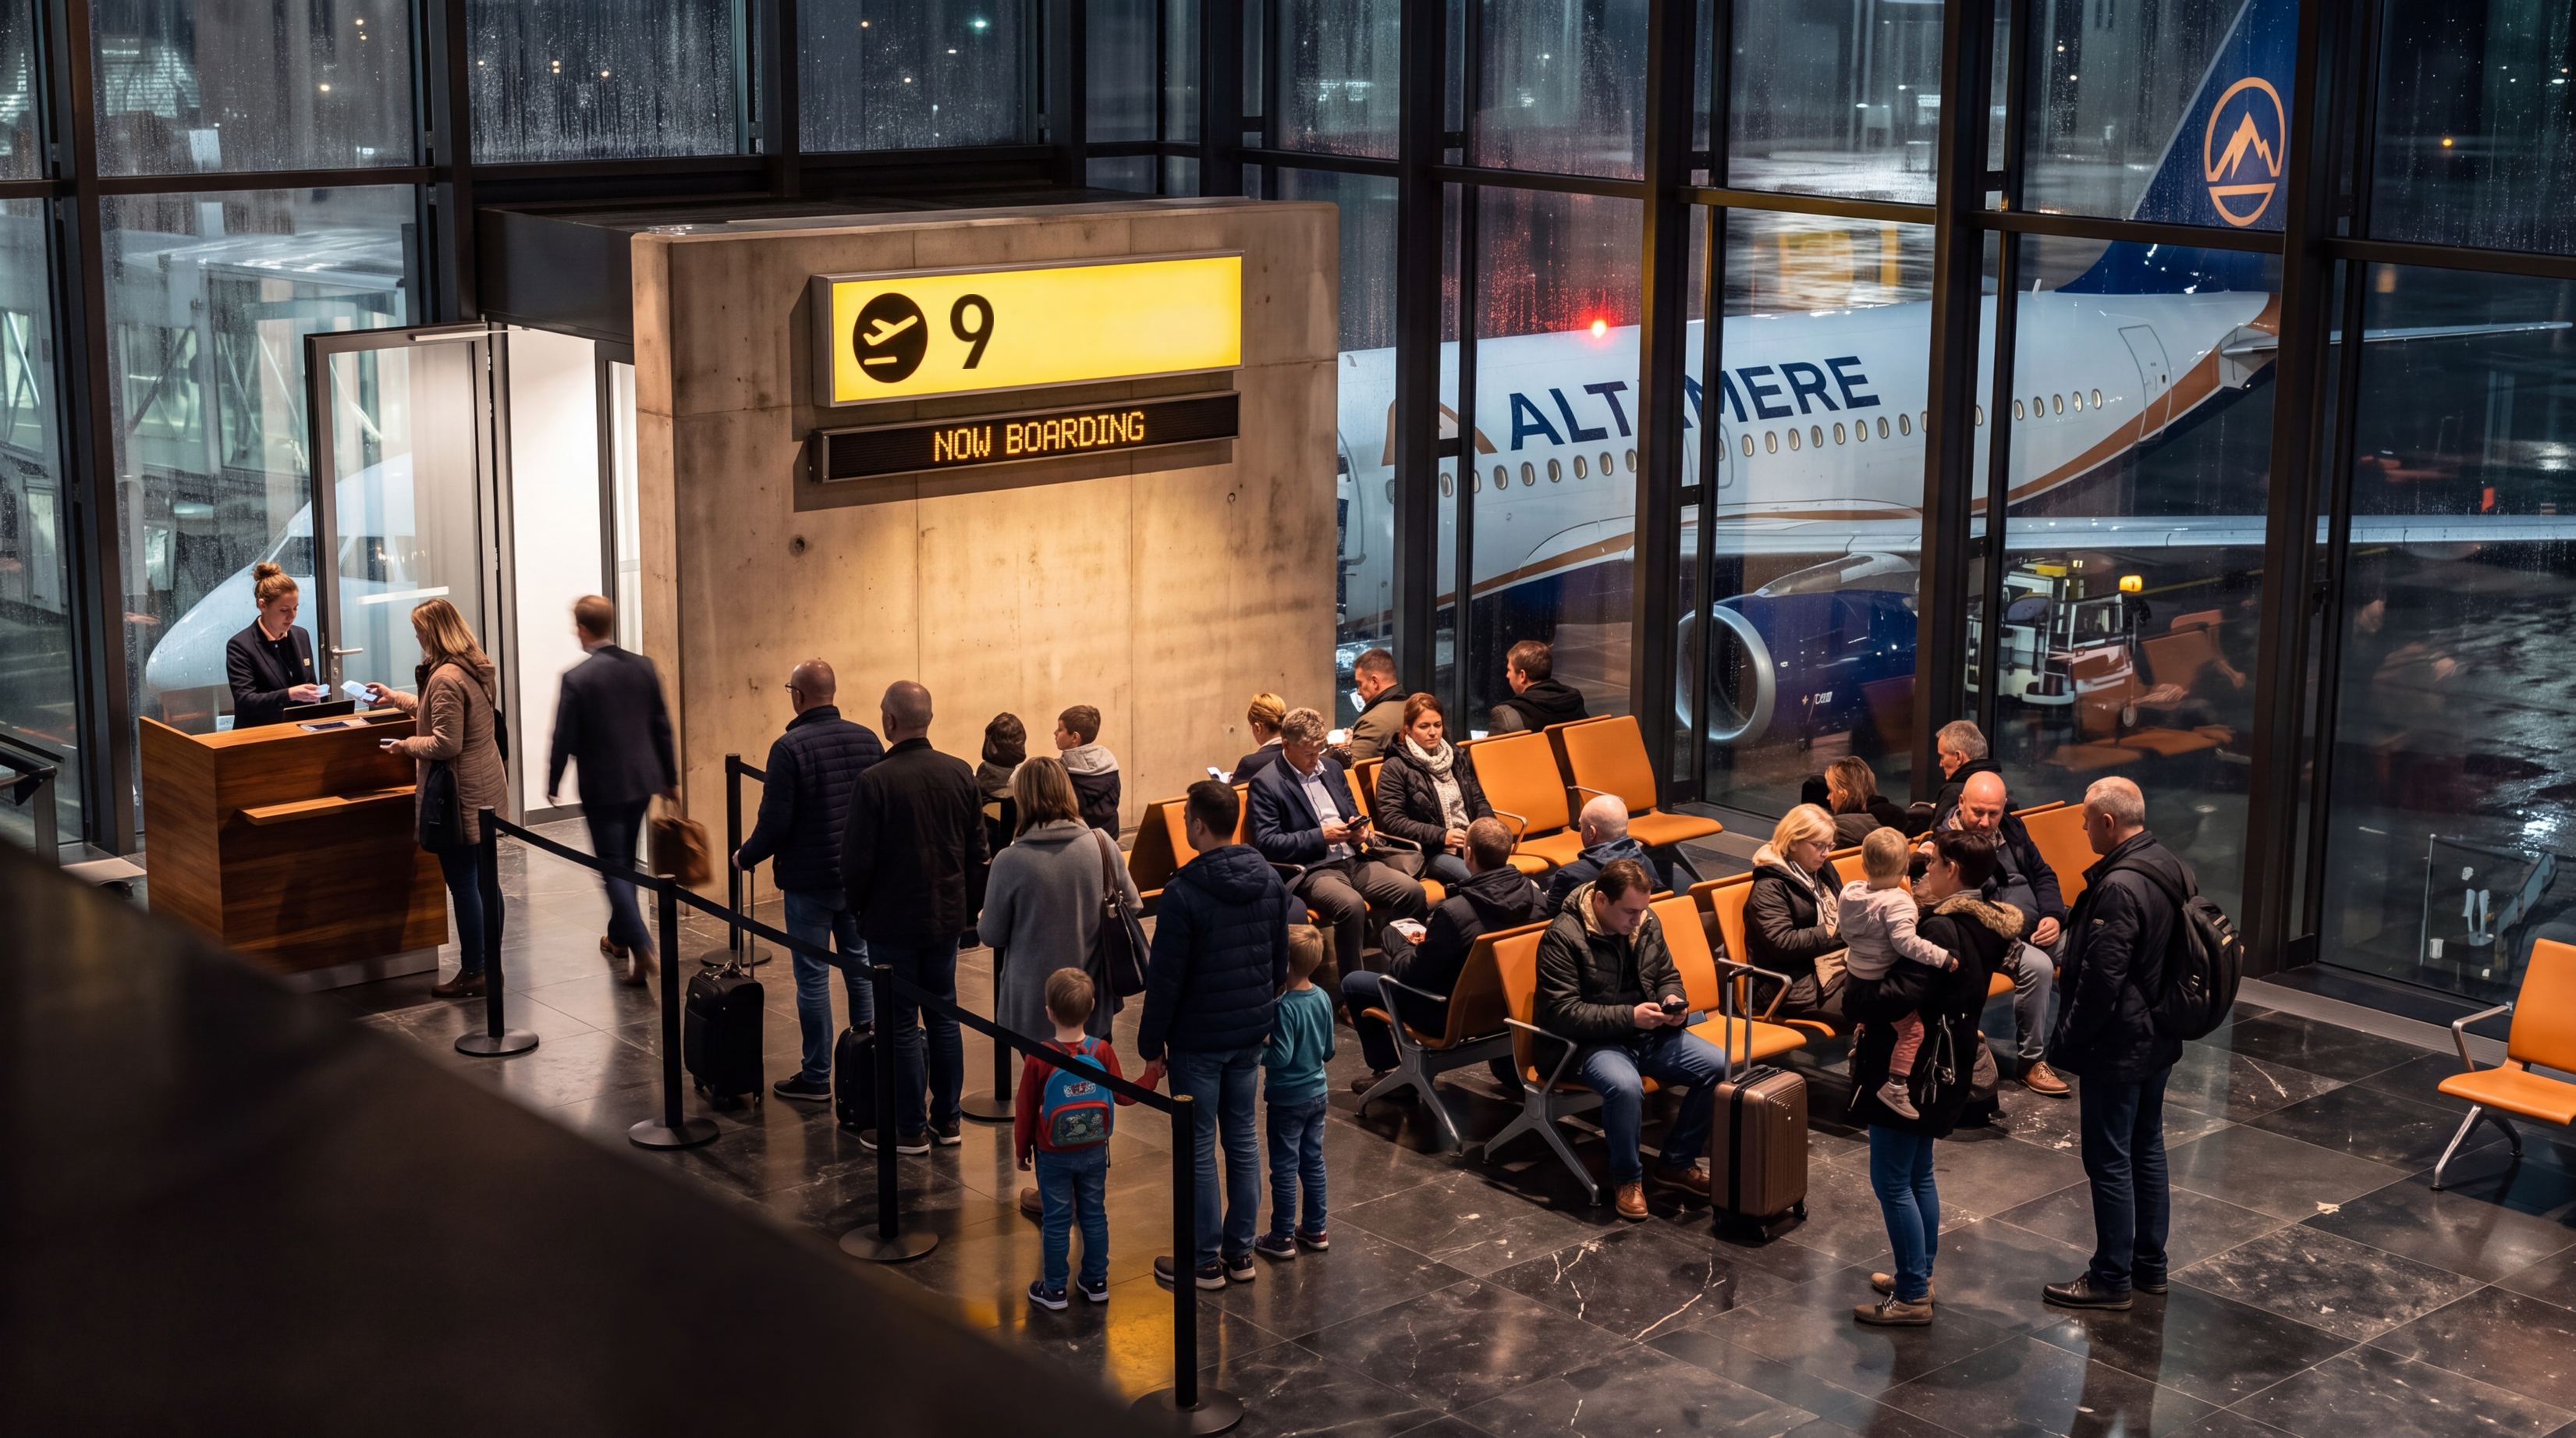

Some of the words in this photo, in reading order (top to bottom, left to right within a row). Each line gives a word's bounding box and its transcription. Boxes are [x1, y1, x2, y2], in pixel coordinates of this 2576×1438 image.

[949, 293, 995, 370] 9
[935, 425, 991, 462] NOW
[1006, 410, 1145, 455] BOARDING
[1510, 355, 1881, 451] ALTMERE
